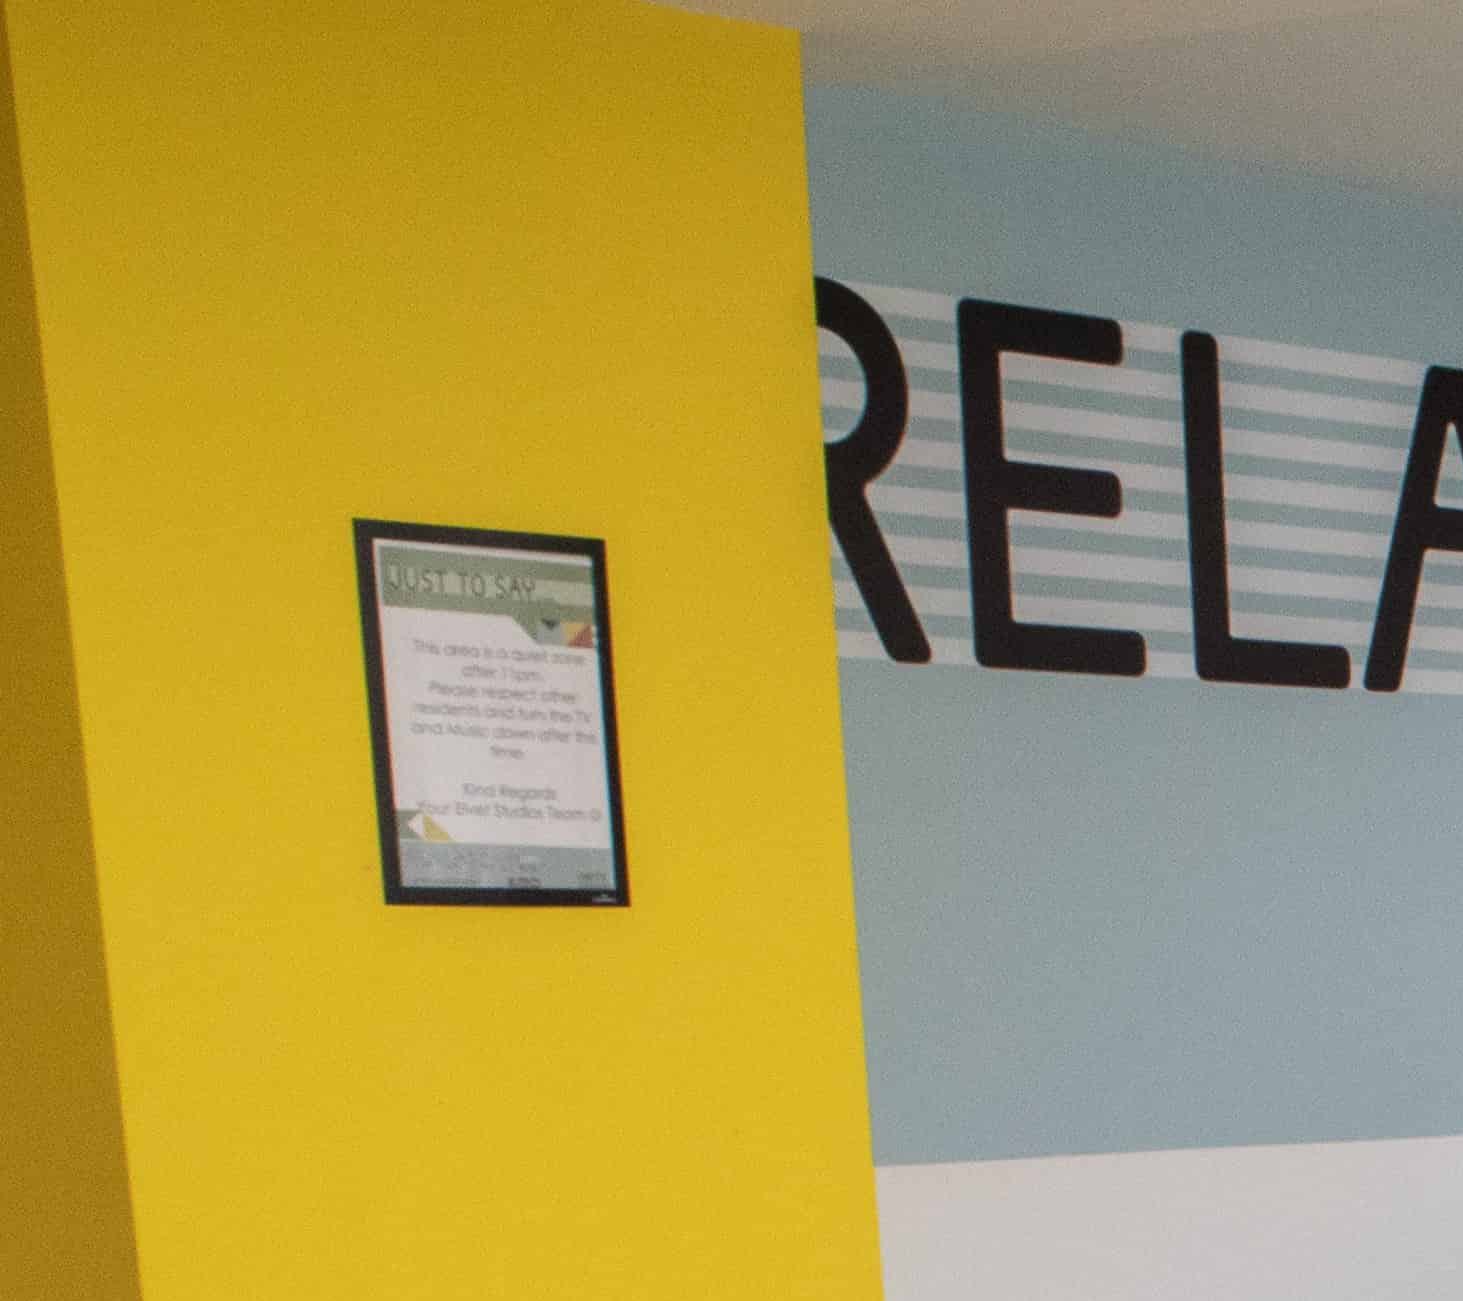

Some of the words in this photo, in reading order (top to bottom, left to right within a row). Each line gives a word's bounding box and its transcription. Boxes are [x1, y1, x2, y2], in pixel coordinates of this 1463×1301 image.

[384, 562, 446, 594] JUST
[455, 573, 487, 599] TO
[493, 574, 537, 601] SAY
